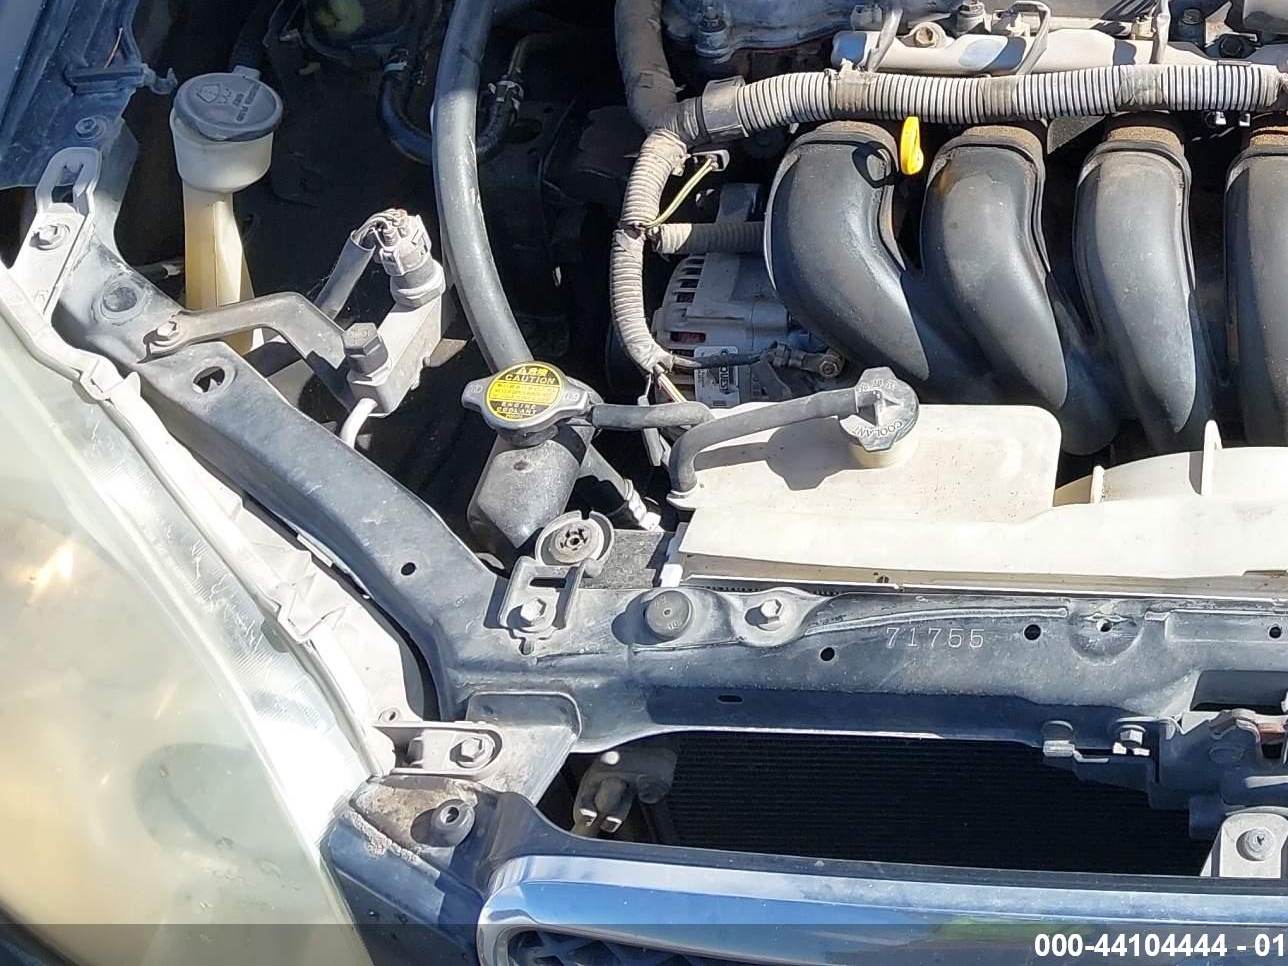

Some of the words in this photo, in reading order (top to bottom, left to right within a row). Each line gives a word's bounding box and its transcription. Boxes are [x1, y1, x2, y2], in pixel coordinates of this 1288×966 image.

[505, 374, 555, 385] CAUTION
[496, 407, 537, 415] COOLANT
[853, 421, 903, 438] COOLANT
[886, 627, 985, 649] 71755
